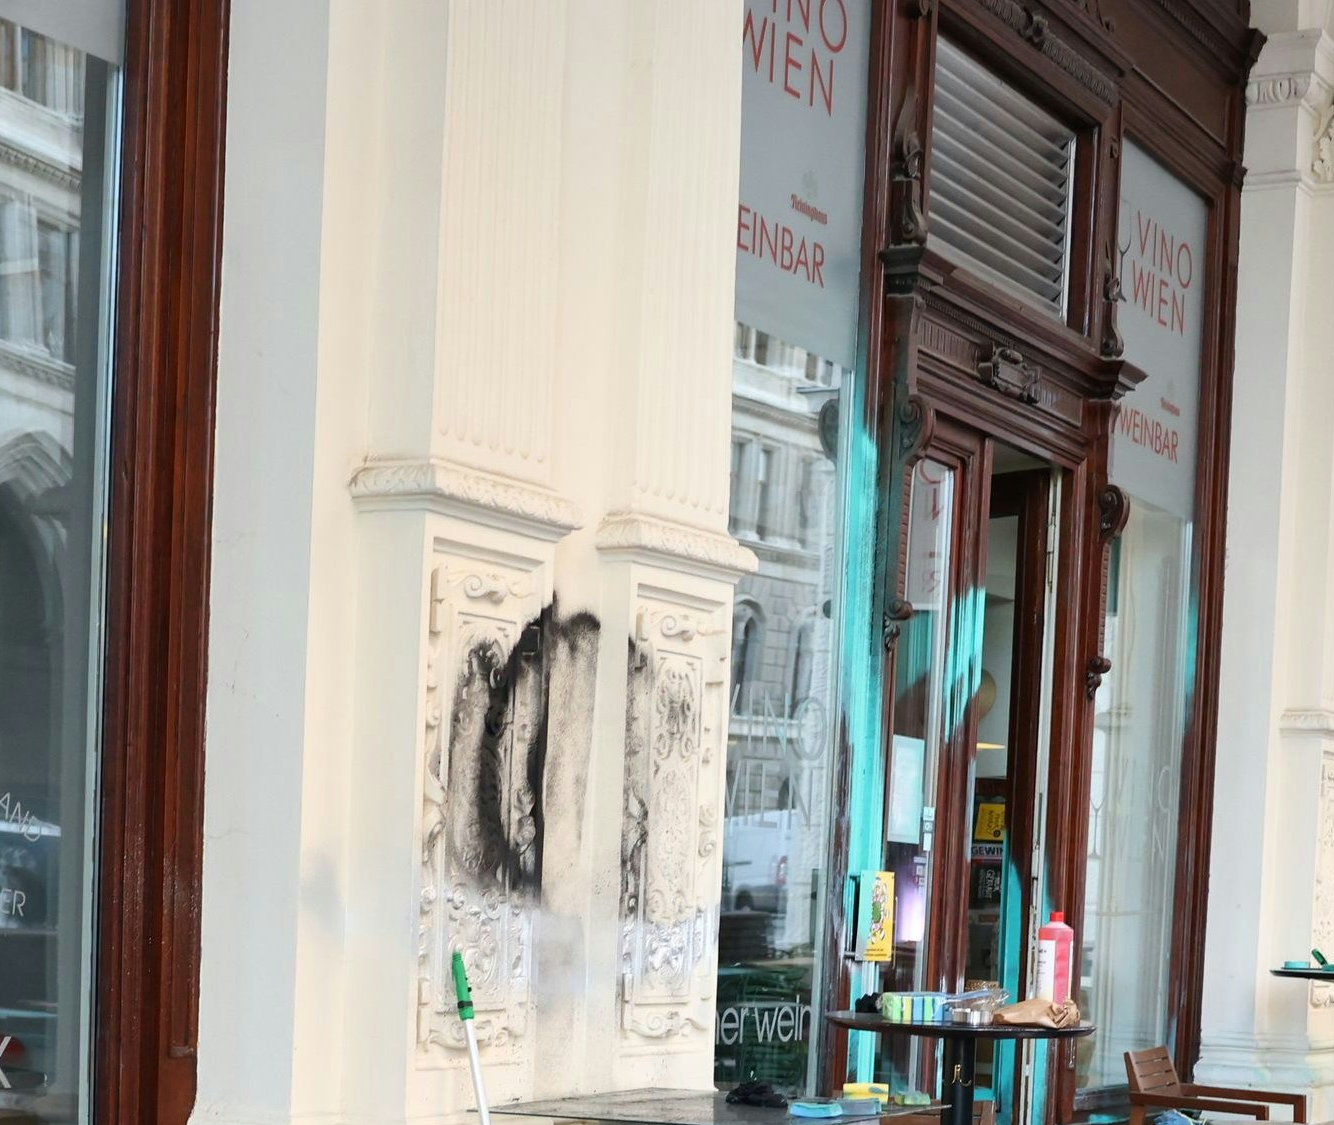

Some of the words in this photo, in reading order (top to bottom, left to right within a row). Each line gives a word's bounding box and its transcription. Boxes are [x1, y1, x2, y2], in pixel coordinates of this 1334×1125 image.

[1137, 210, 1193, 289] VINO
[1132, 260, 1186, 336] WIEN
[1120, 401, 1179, 464] WEINBAR
[753, 993, 813, 1043] wein
